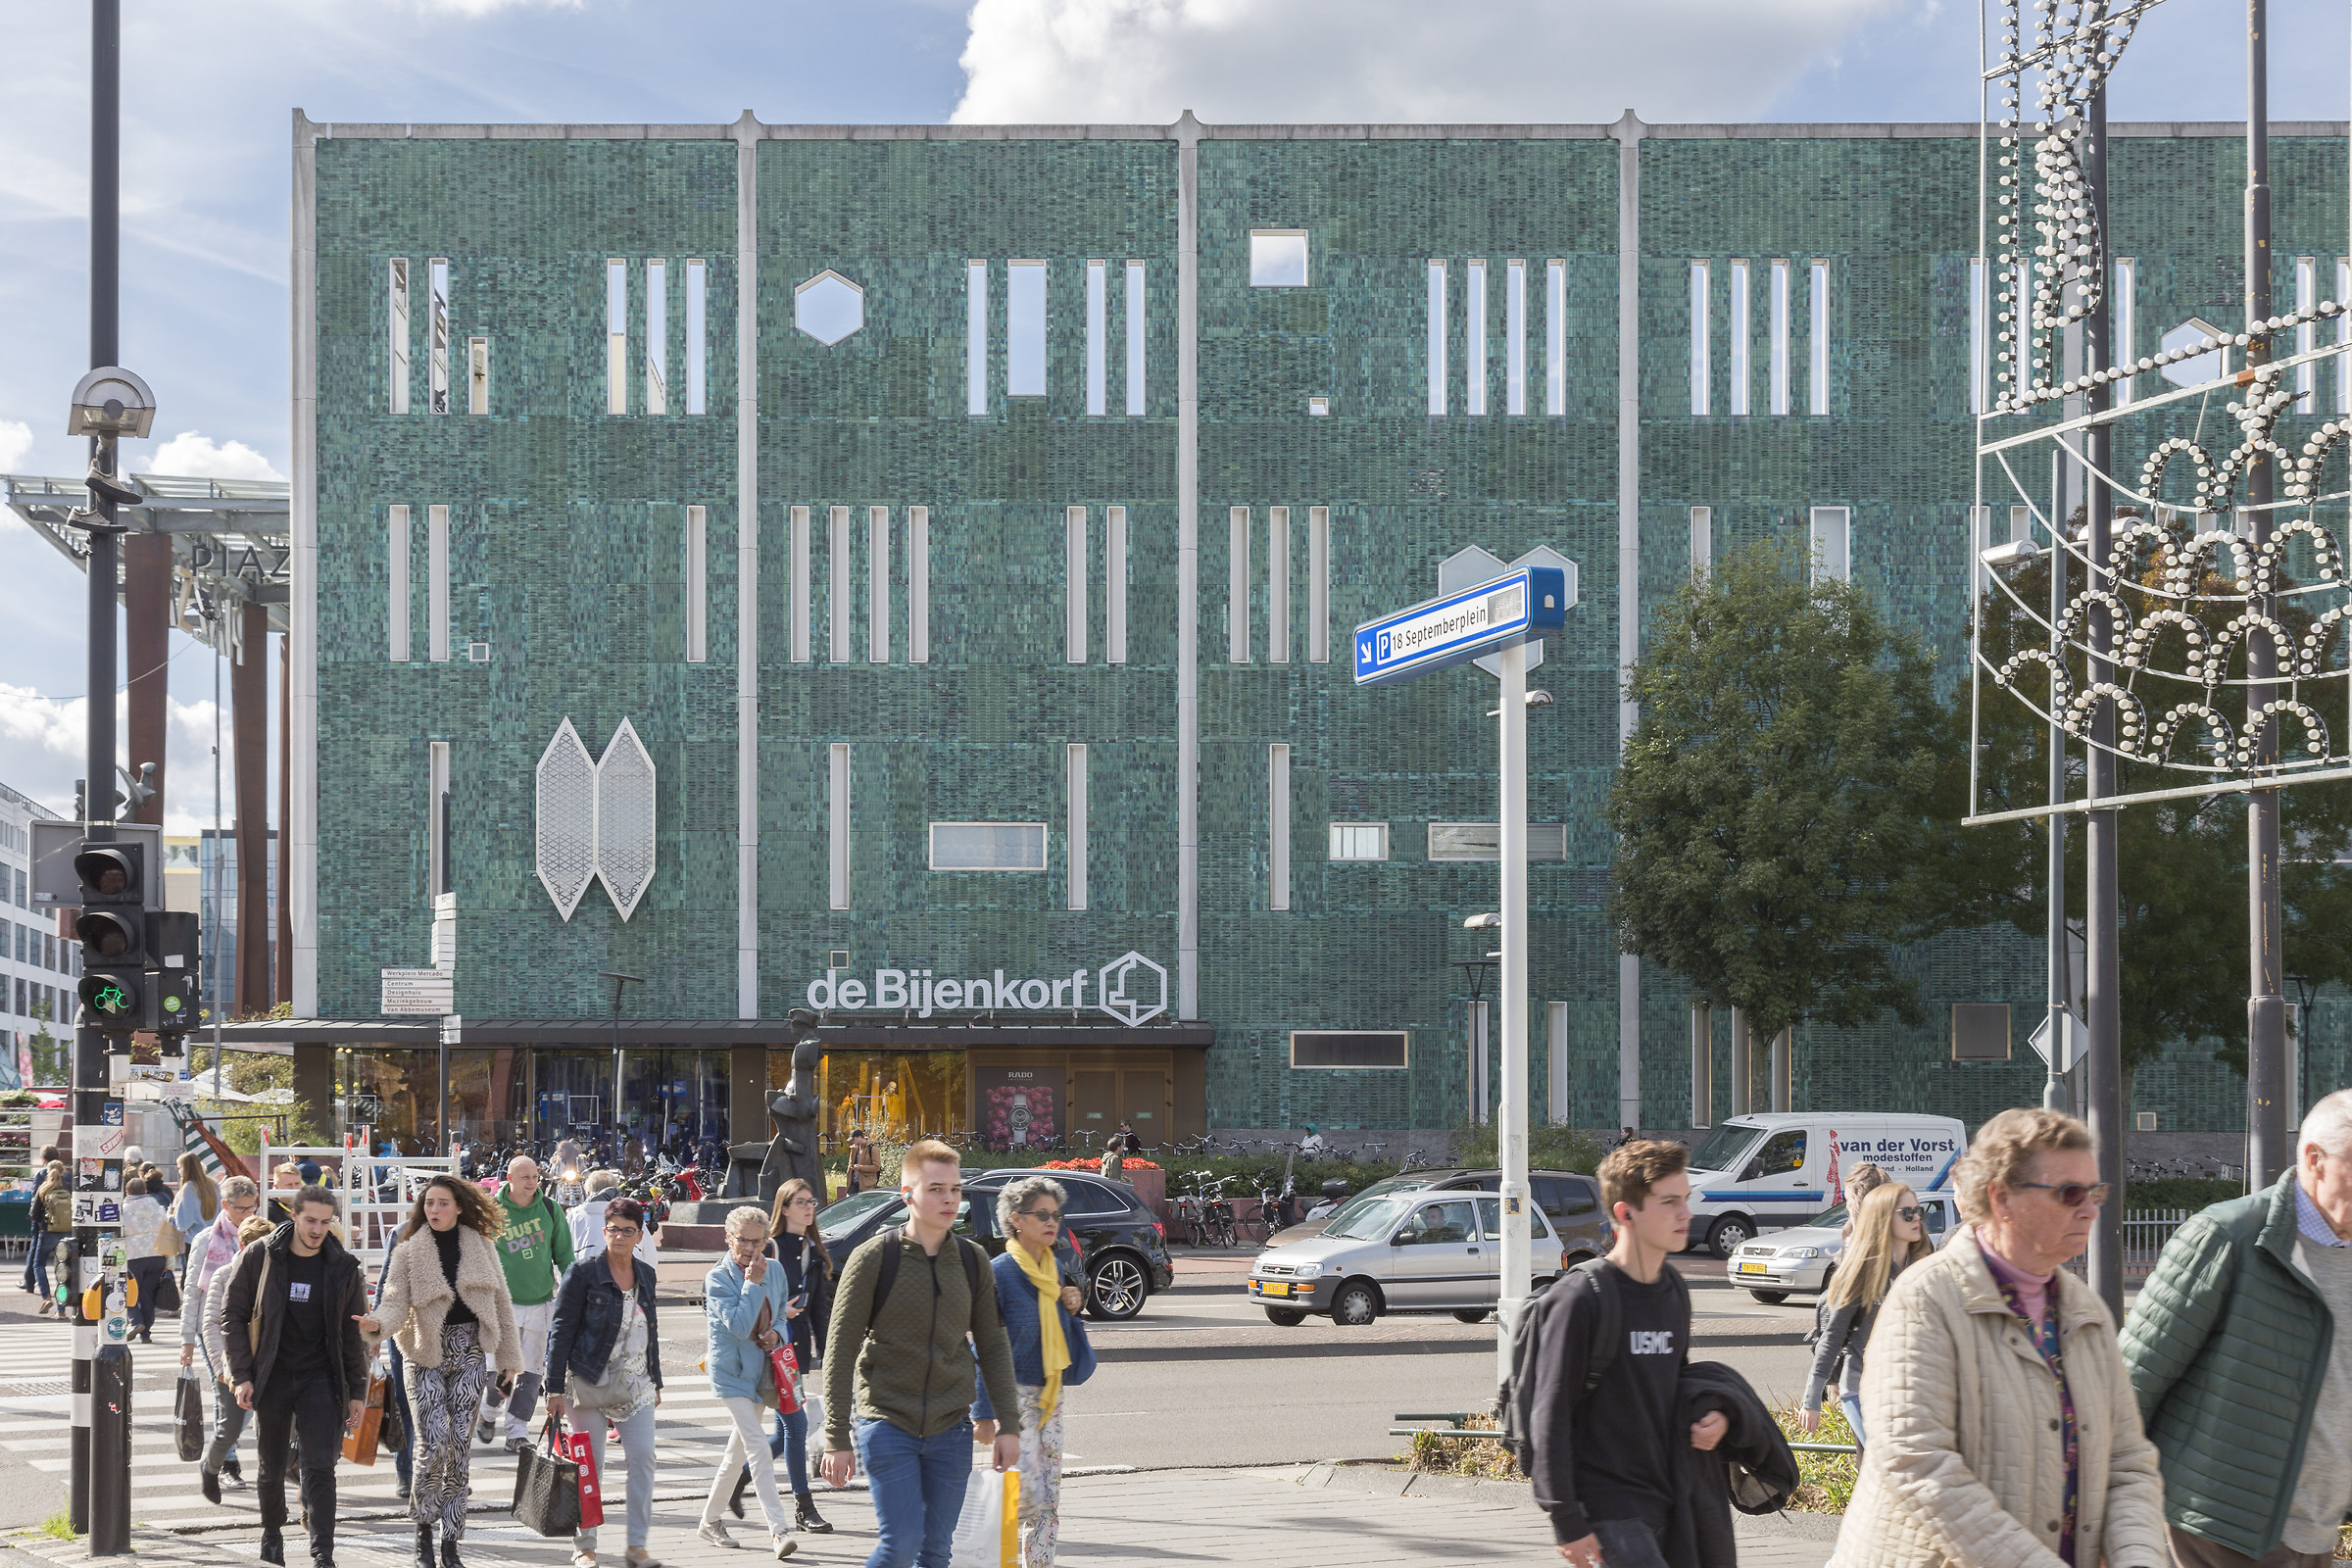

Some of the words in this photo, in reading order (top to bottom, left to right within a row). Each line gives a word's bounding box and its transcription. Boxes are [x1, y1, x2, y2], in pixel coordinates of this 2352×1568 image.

[192, 545, 290, 578] PIAZ
[1392, 633, 1403, 651] 18
[1405, 606, 1486, 648] Septemberplein
[807, 969, 867, 1009] de
[875, 968, 1088, 1019] Bijenkorf
[1839, 1141, 1871, 1152] van
[1877, 1138, 1905, 1152] der
[1910, 1138, 1954, 1152] Vorst
[1863, 1152, 1933, 1162] modestoffen
[504, 1217, 541, 1241] JUST
[507, 1236, 531, 1253] DO
[529, 1230, 545, 1246] IT
[1630, 1331, 1674, 1354] USMC
